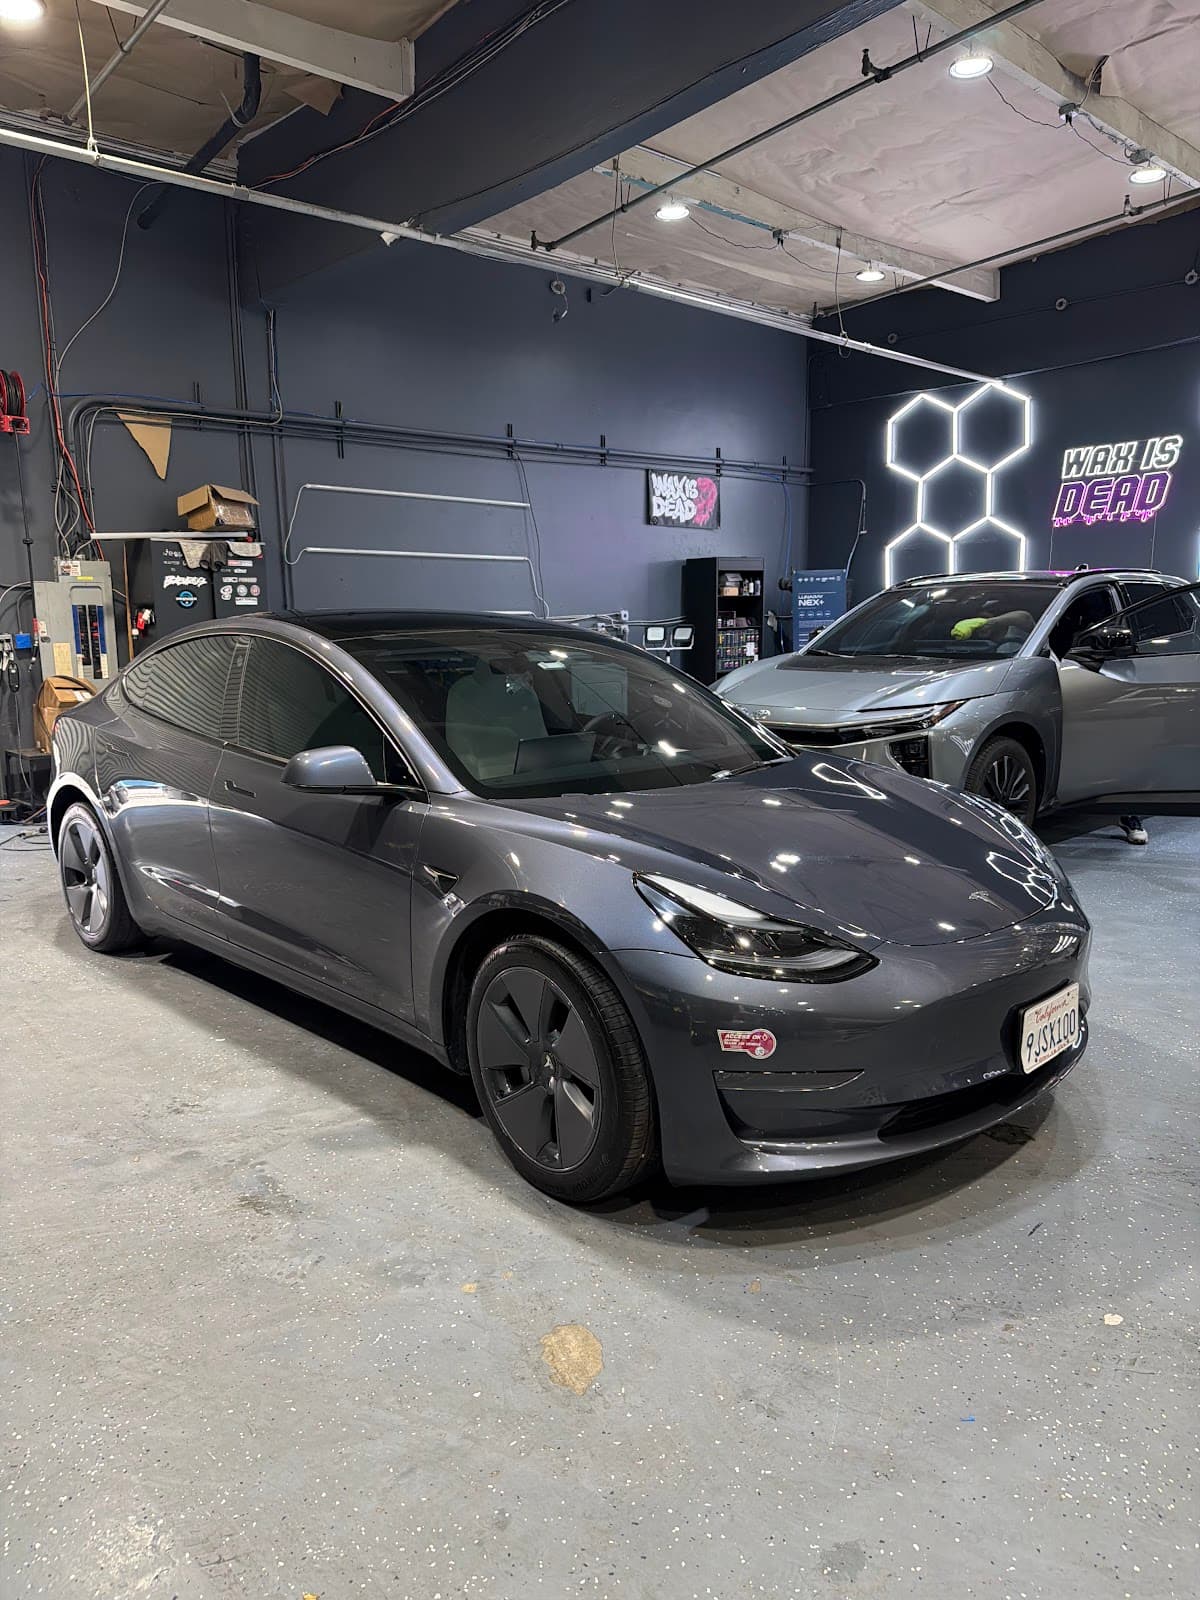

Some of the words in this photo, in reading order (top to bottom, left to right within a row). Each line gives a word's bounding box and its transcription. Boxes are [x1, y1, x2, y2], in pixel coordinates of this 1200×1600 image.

[1061, 441, 1138, 479] WAX
[1139, 434, 1183, 470] IS
[651, 473, 687, 501] WAX
[685, 479, 699, 499] IS
[1051, 470, 1172, 526] DEAD
[652, 495, 697, 523] DEAD
[798, 599, 824, 607] NEX+
[1035, 1000, 1069, 1024] California
[1026, 1008, 1076, 1062] 9JSX100
